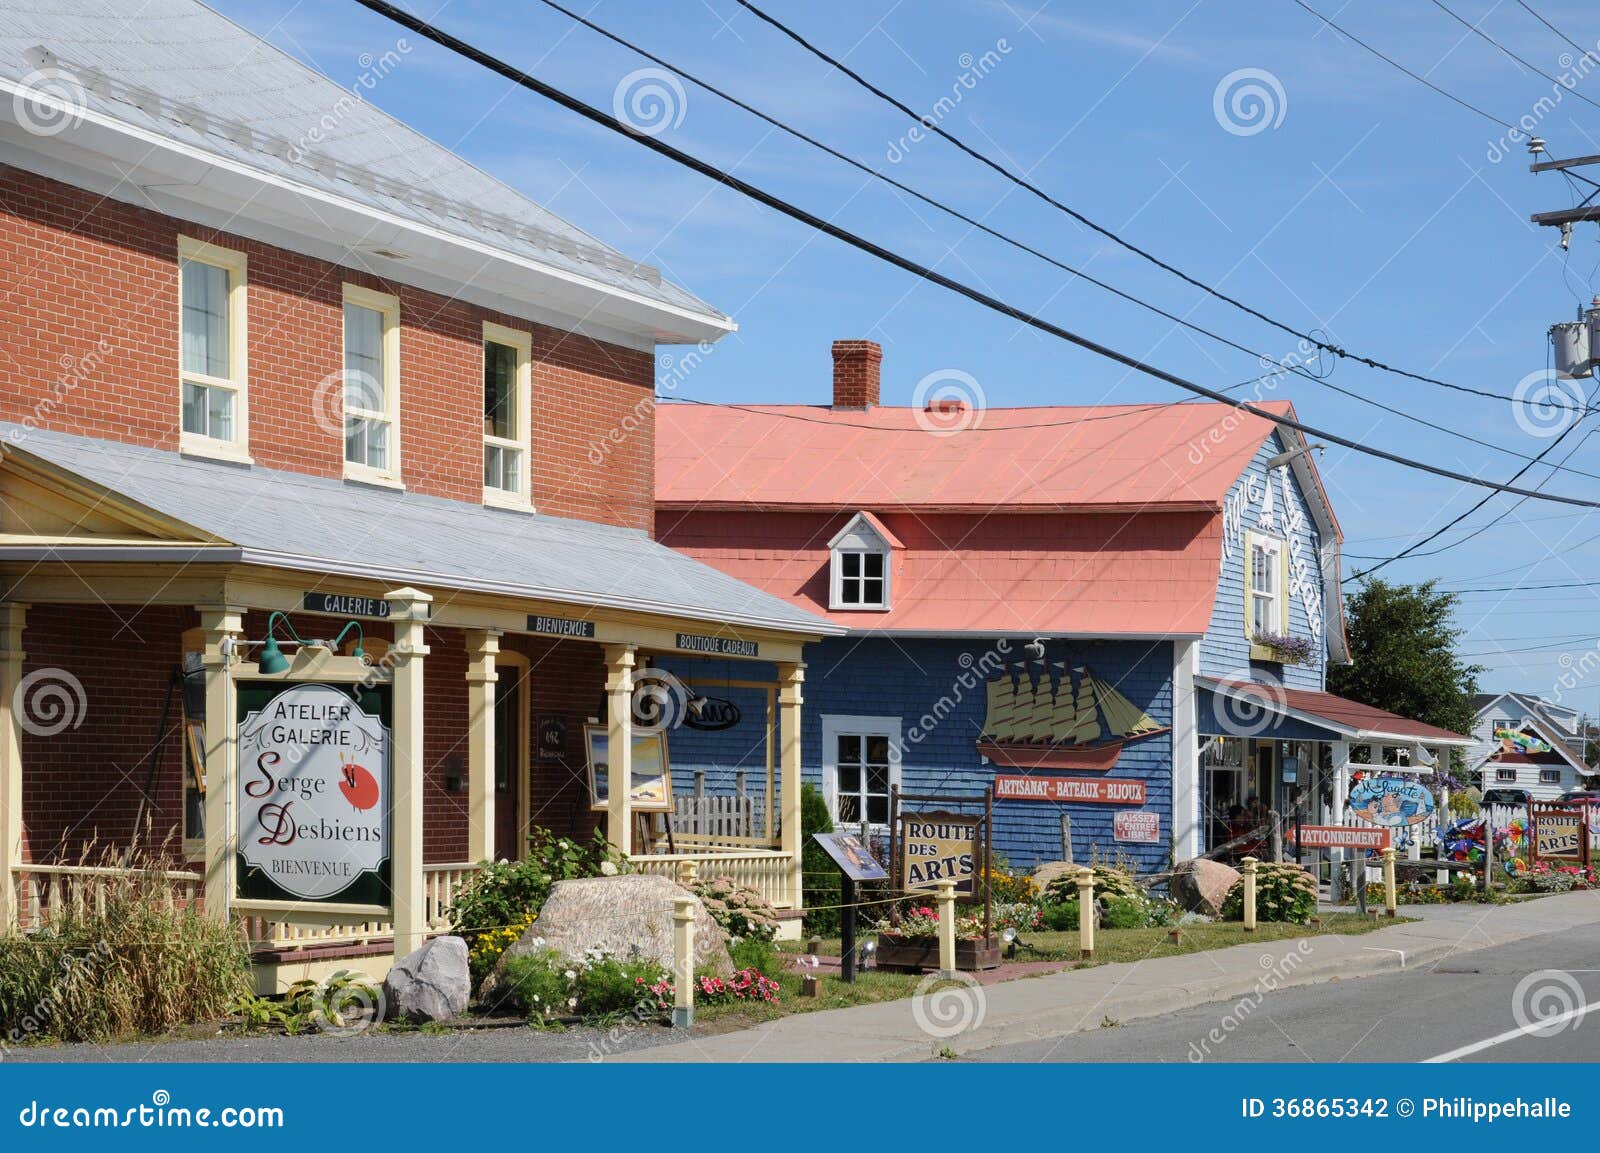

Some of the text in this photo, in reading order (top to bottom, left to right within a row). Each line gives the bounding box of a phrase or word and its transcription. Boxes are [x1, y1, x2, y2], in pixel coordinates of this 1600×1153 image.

[324, 595, 373, 615] GALERIE
[536, 617, 587, 636] BIENVENUE
[680, 634, 755, 656] BOUTIQUE CADEAUX
[274, 701, 350, 721] ATELIER
[272, 725, 350, 746] GALERIE
[245, 751, 326, 801] Serge
[997, 779, 1142, 800] ARTISANAT BATEAUX BIJOUX
[258, 801, 381, 846] Desbiens
[1538, 816, 1579, 826] ROUTE
[909, 823, 975, 841] ROUTE
[1122, 831, 1152, 840] LIBRE
[909, 843, 937, 856] DES
[1539, 834, 1579, 851] ARTS
[272, 859, 351, 877] BIENVENUE
[908, 854, 975, 884] ARTS
